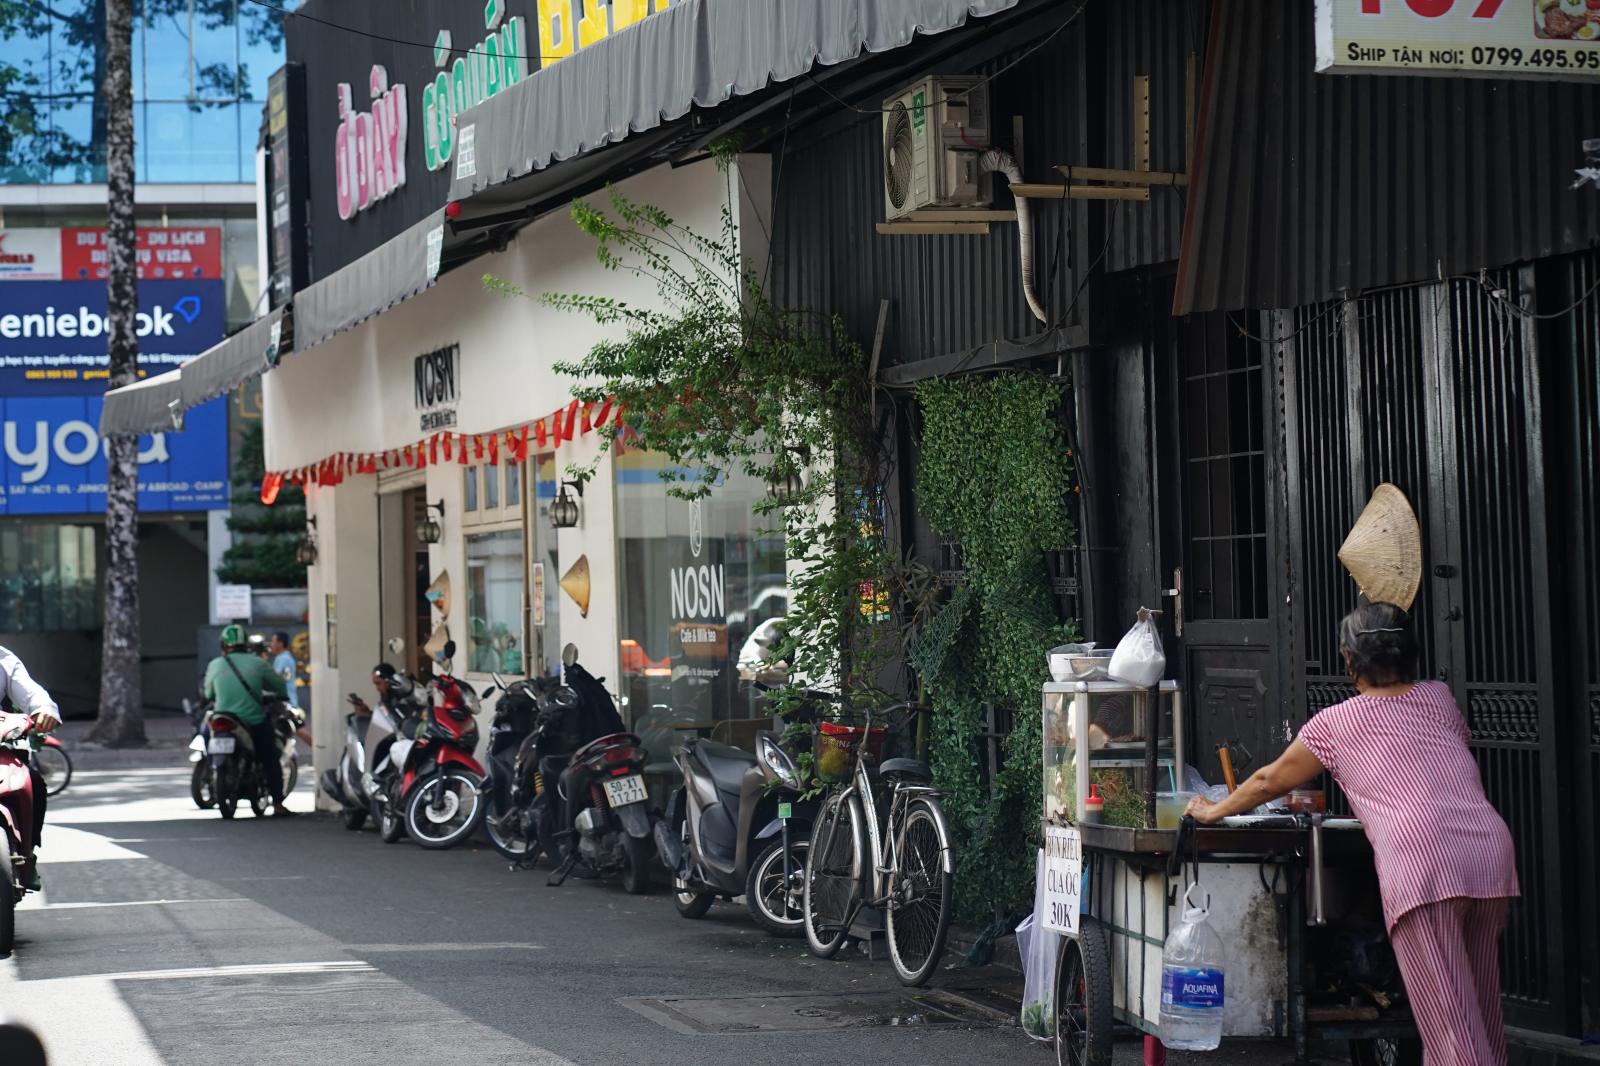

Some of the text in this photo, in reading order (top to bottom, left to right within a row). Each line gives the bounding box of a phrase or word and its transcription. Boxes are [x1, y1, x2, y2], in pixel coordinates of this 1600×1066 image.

[1392, 45, 1422, 66] TẬN
[156, 250, 192, 263] VISA
[0, 305, 175, 338] eniebok
[671, 563, 725, 619] NOSN
[1050, 901, 1073, 928] 30K
[1182, 983, 1218, 995] AQUAFINA
